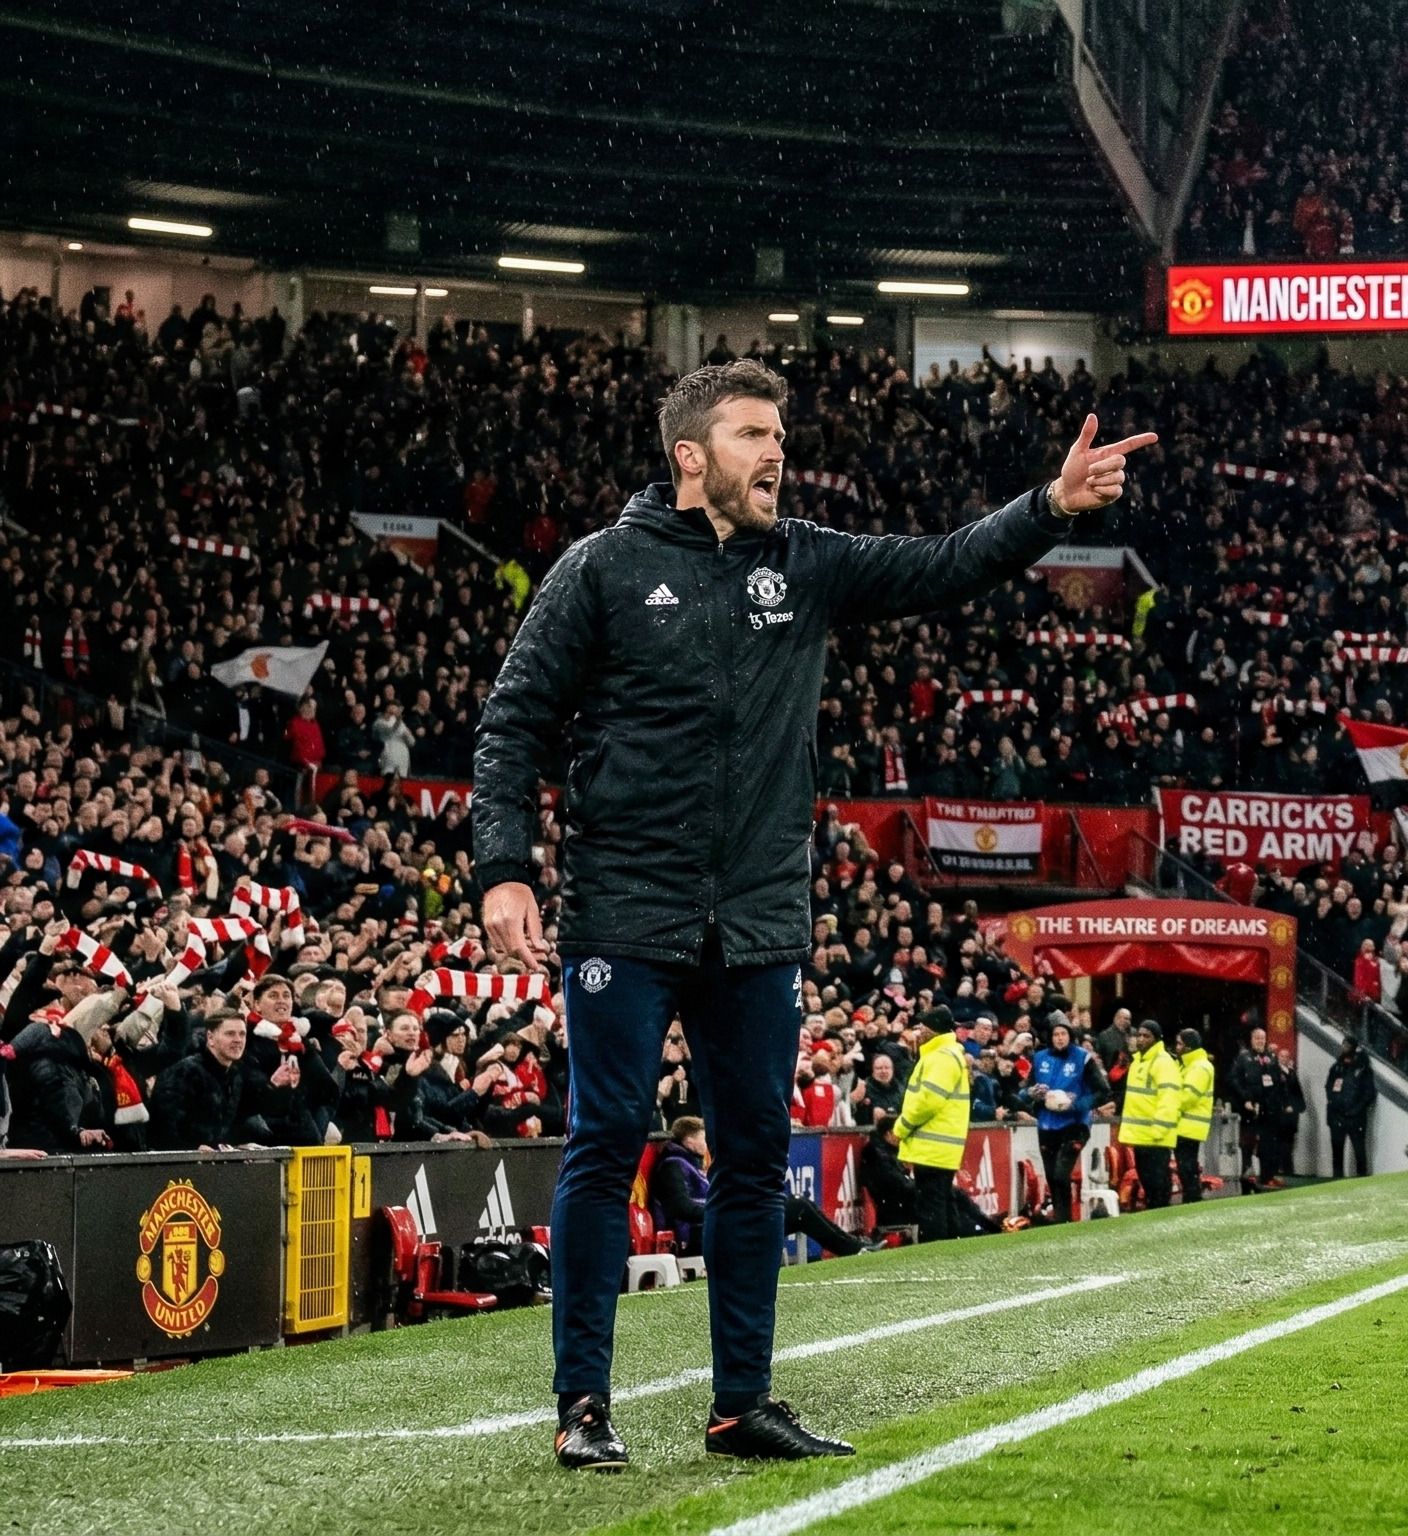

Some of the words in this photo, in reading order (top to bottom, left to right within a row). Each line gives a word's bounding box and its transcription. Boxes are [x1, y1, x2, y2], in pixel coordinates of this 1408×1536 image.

[1180, 795, 1355, 830] CARRICK'S
[1180, 825, 1249, 858] RED
[1258, 831, 1358, 861] ARMY
[1036, 916, 1073, 934] THE
[1077, 916, 1157, 935] THEATRE
[1161, 917, 1187, 935] OF
[1190, 918, 1268, 937] DREAMS
[144, 1190, 217, 1242] MANCHESTER
[154, 1299, 206, 1328] UNITED
